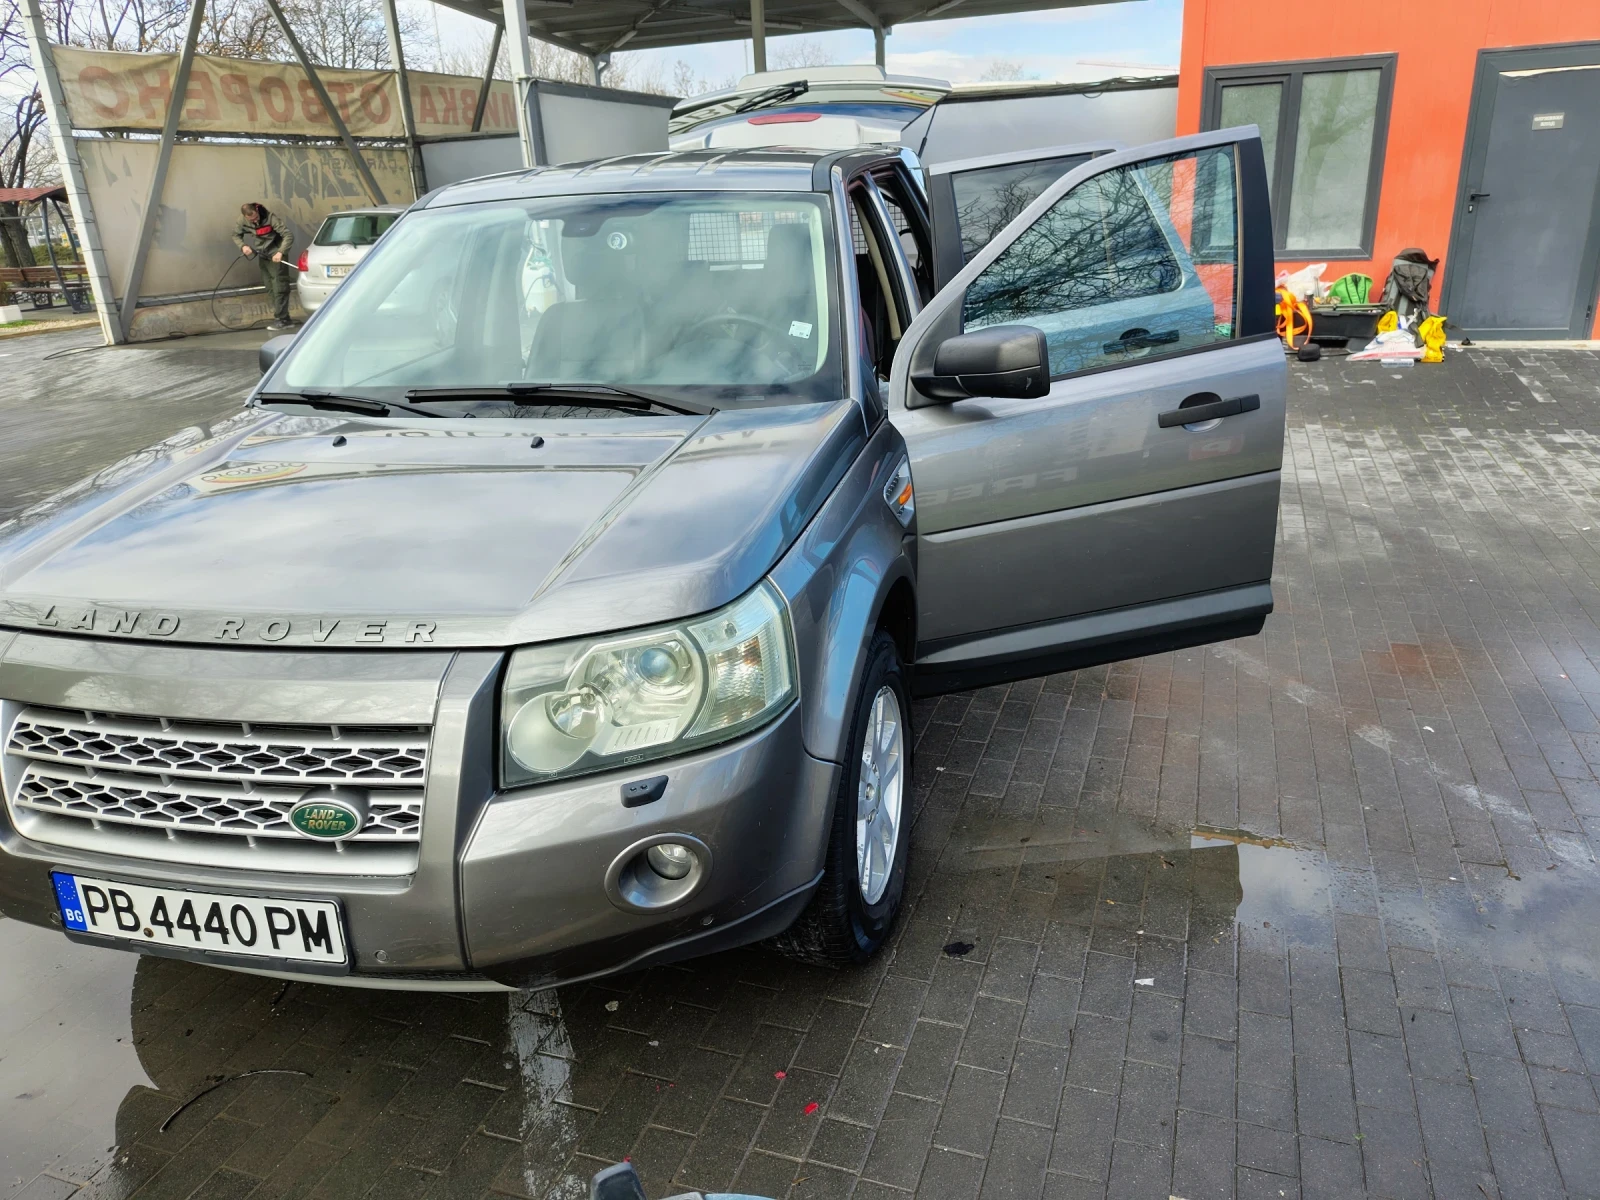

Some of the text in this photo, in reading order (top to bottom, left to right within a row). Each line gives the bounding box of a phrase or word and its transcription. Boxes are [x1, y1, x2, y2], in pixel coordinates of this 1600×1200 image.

[37, 604, 437, 643] LAND ROVER
[304, 808, 336, 820] LAND
[307, 819, 347, 831] ROVER
[65, 907, 84, 922] BG
[81, 883, 335, 955] PB 4440 PM
